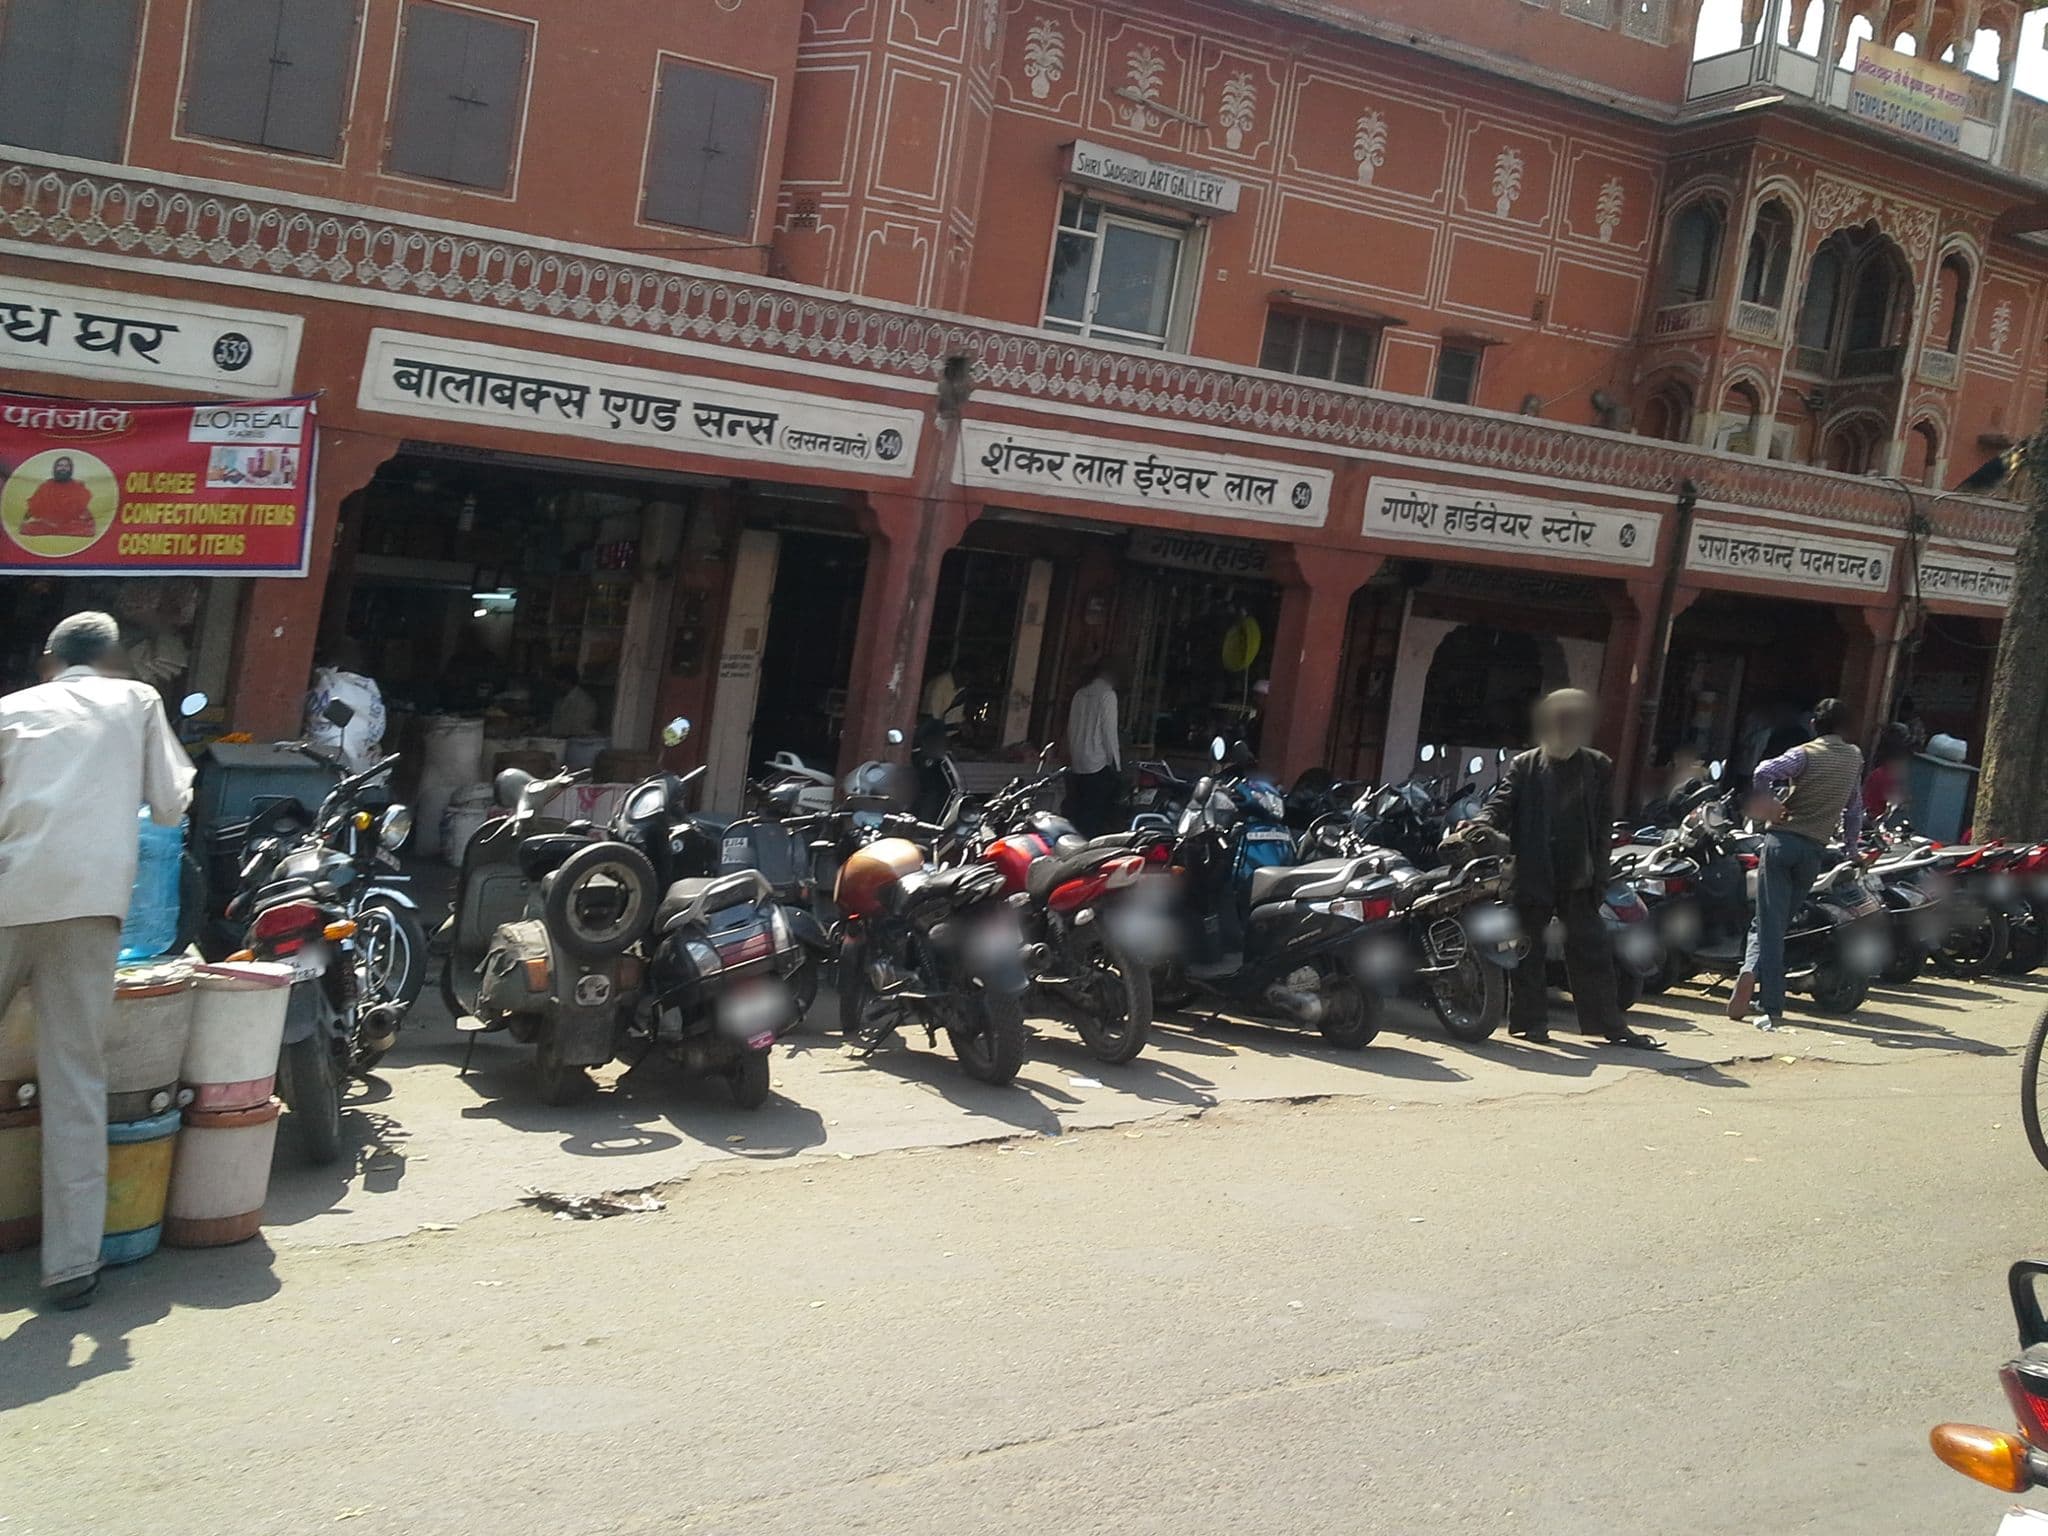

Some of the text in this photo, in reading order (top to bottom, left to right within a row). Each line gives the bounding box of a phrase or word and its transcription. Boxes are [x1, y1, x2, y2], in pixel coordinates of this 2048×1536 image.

[1077, 152, 1101, 174] SHRI
[1103, 158, 1147, 187] SADGURU
[1148, 169, 1170, 193] ART
[1170, 175, 1223, 205] GALLERY
[74, 311, 182, 365] घर
[393, 357, 590, 419] बालाबक्स
[600, 388, 682, 431] एण्ड
[693, 402, 779, 446] सन्स
[980, 436, 1069, 481] शंकर
[1073, 453, 1128, 487] लाल
[1132, 453, 1217, 499] ईश्वर
[1223, 471, 1278, 505] लाल
[121, 503, 297, 527] CONFECTIONERY ITEMS
[1380, 491, 1436, 529] गणेश
[1443, 500, 1532, 540] हार्डवेयर
[1540, 511, 1597, 547] स्टोर
[118, 532, 247, 556] COSMETIC ITEMS
